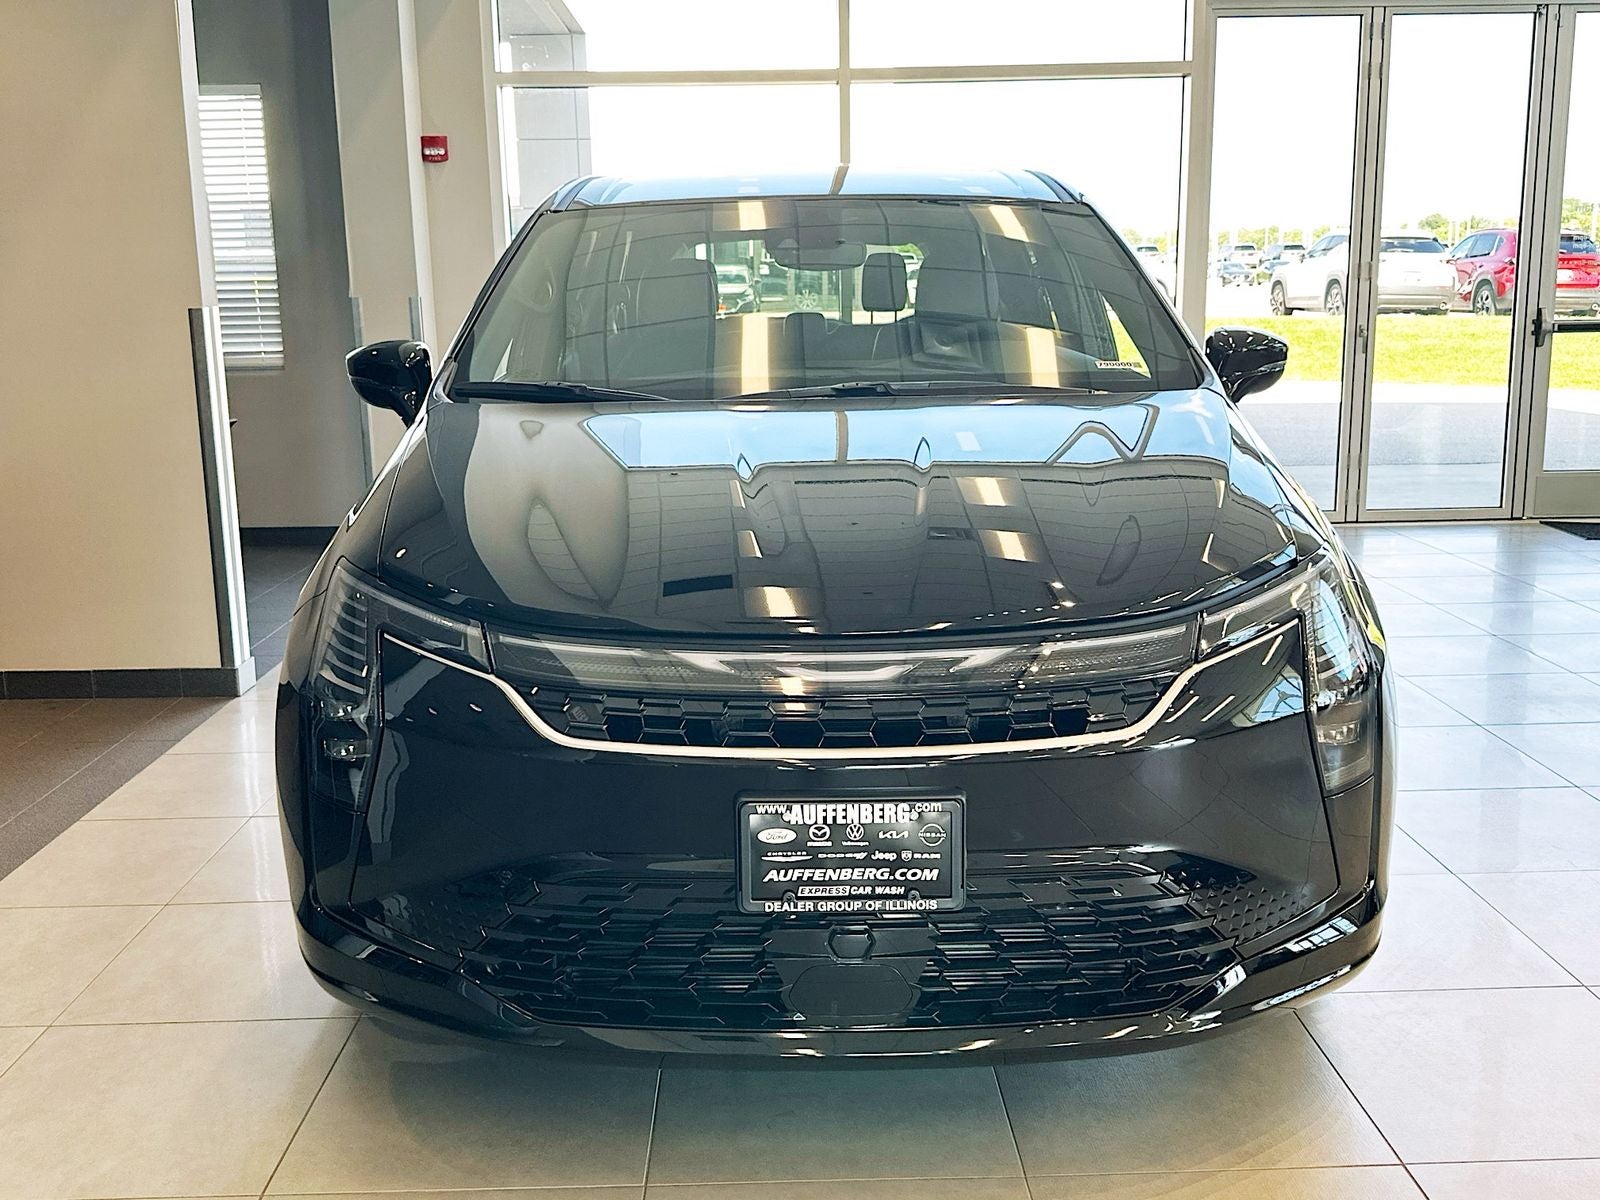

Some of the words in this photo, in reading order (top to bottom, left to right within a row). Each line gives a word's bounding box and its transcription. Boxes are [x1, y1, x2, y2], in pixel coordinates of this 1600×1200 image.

[871, 850, 897, 861] Jeep
[762, 867, 940, 882] AUFFENBERG.COM
[799, 886, 849, 896] EXPRESS
[850, 886, 873, 895] CAR
[875, 886, 905, 895] WASH
[764, 901, 815, 913] DEALER
[817, 900, 862, 912] GROUP
[865, 900, 882, 911] OF
[885, 899, 938, 911] ILLINOIS
